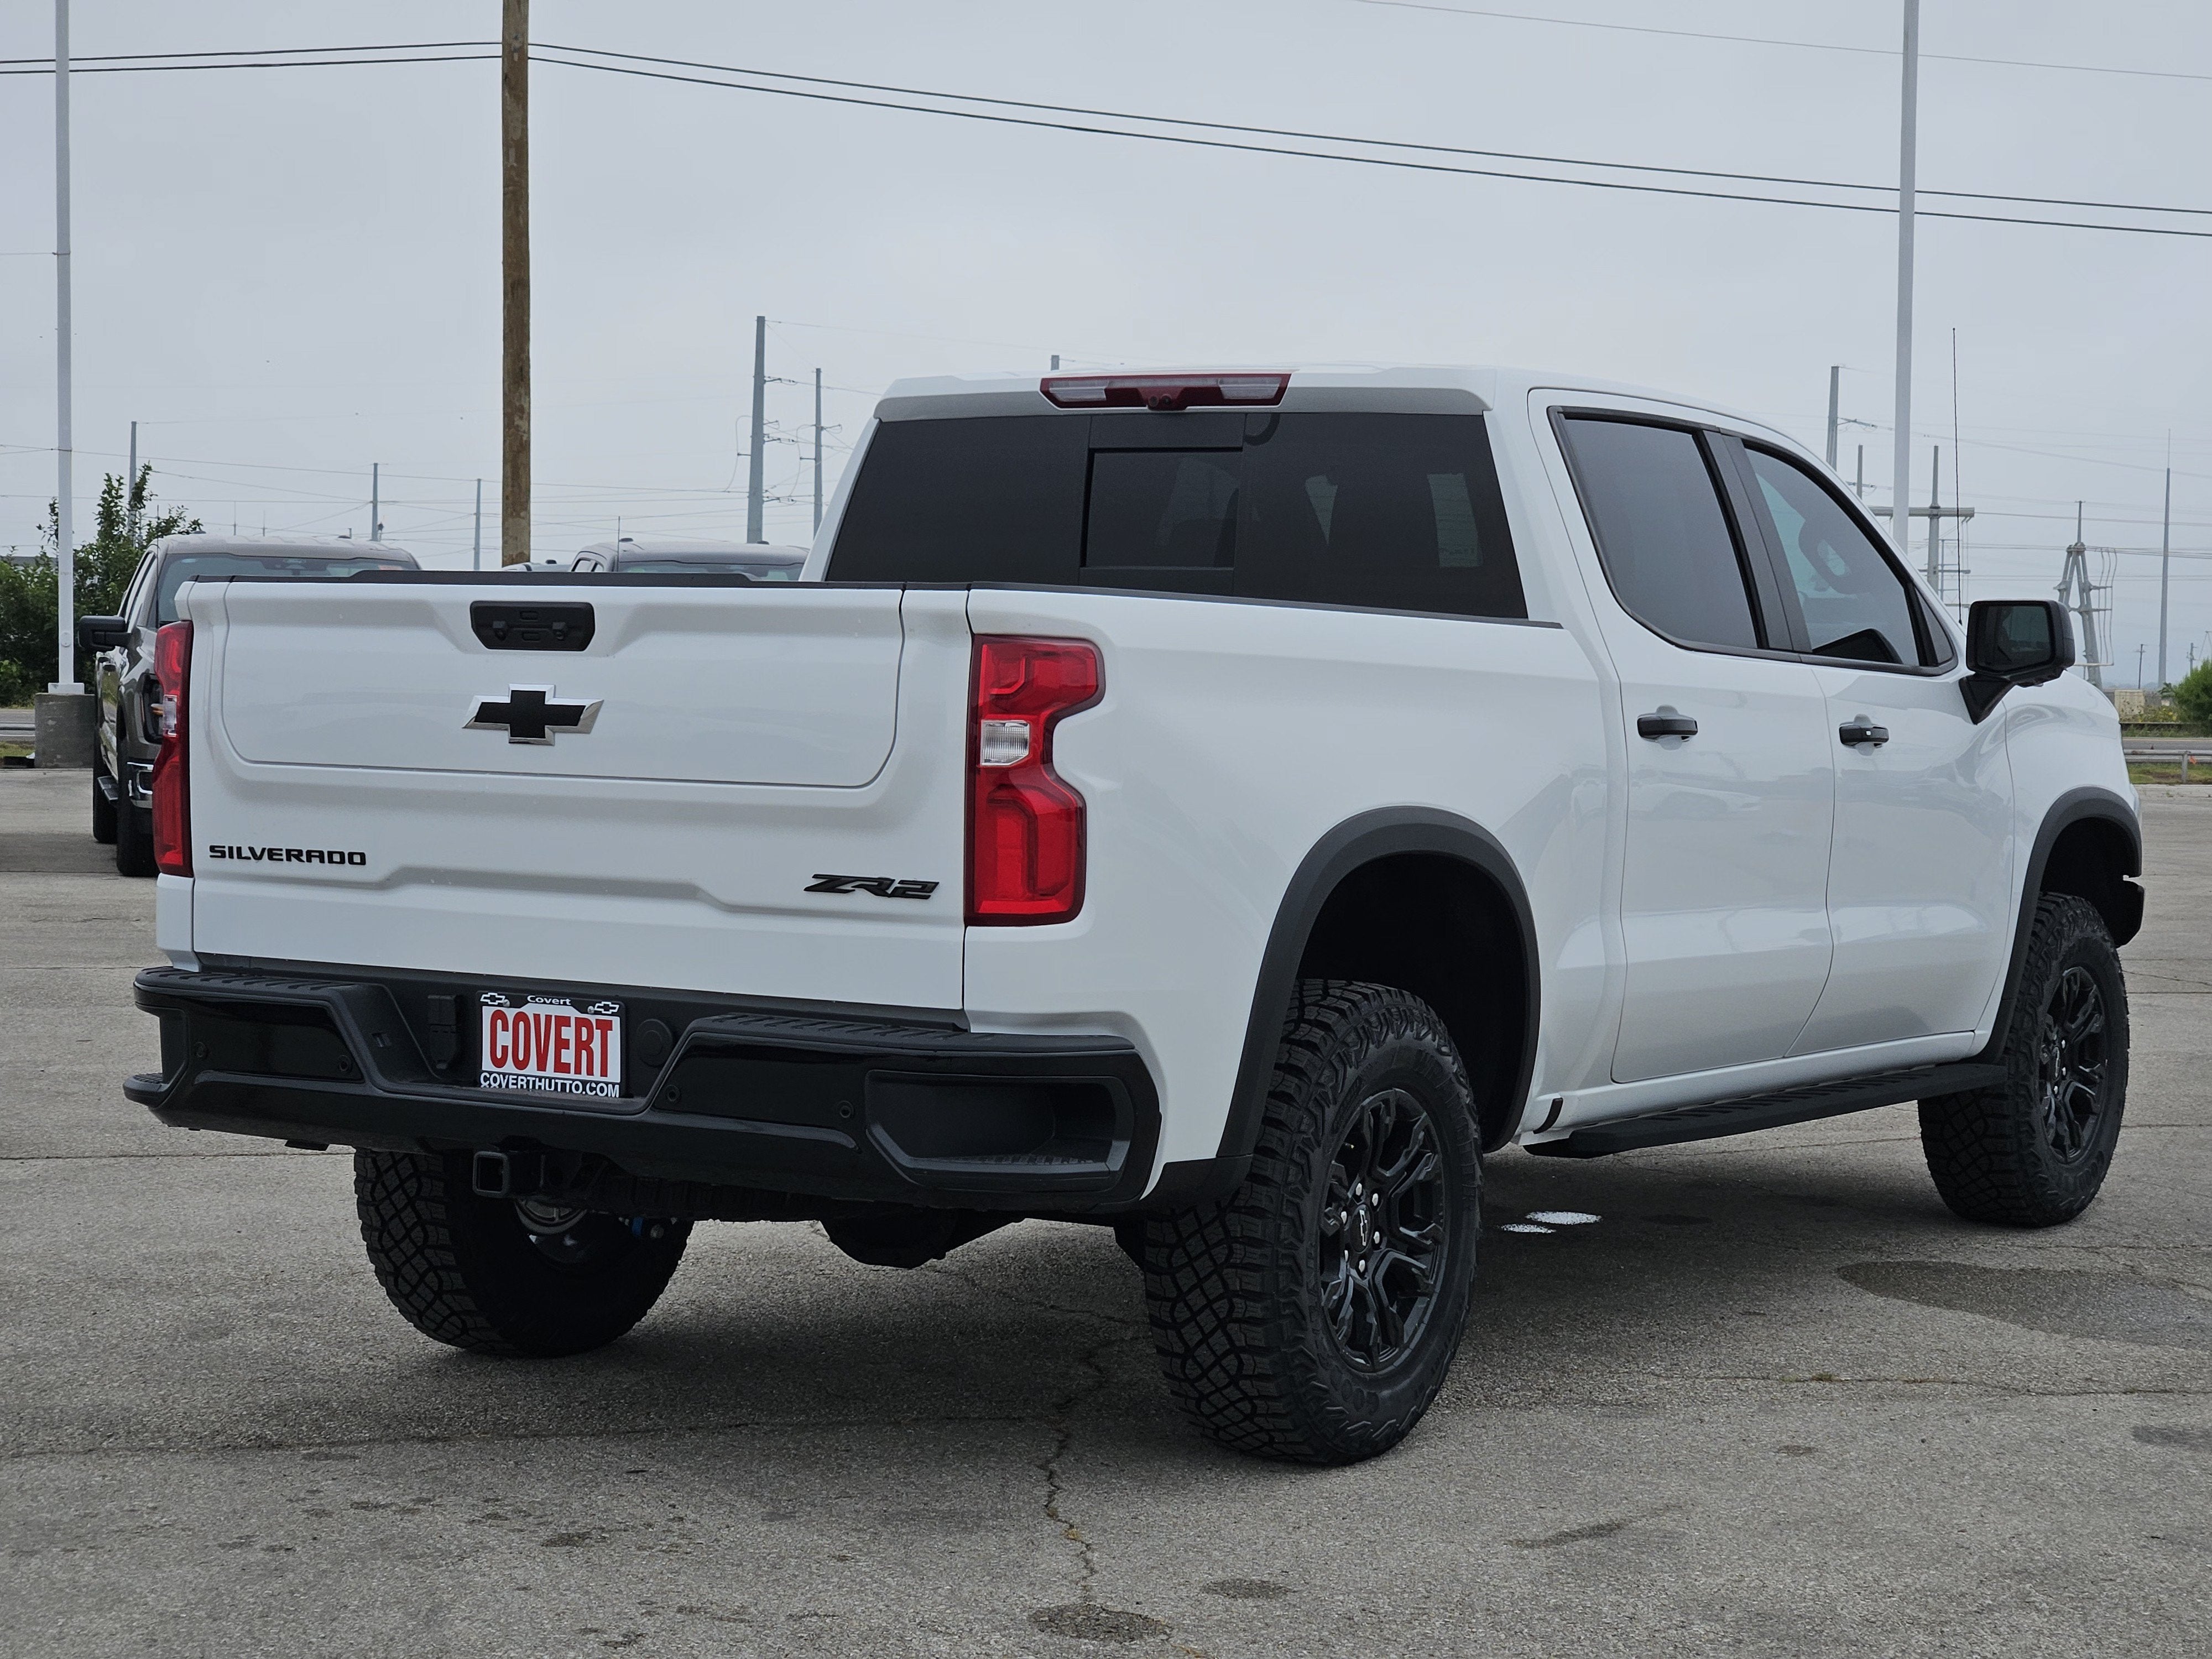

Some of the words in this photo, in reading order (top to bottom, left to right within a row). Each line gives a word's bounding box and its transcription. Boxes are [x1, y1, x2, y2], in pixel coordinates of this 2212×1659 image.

[209, 845, 367, 865] SILVERADO
[804, 874, 940, 899] ZR2
[527, 995, 571, 1005] Covert
[490, 1009, 613, 1077] COVERT
[480, 1072, 619, 1098] COVERTHUTTO.COM
